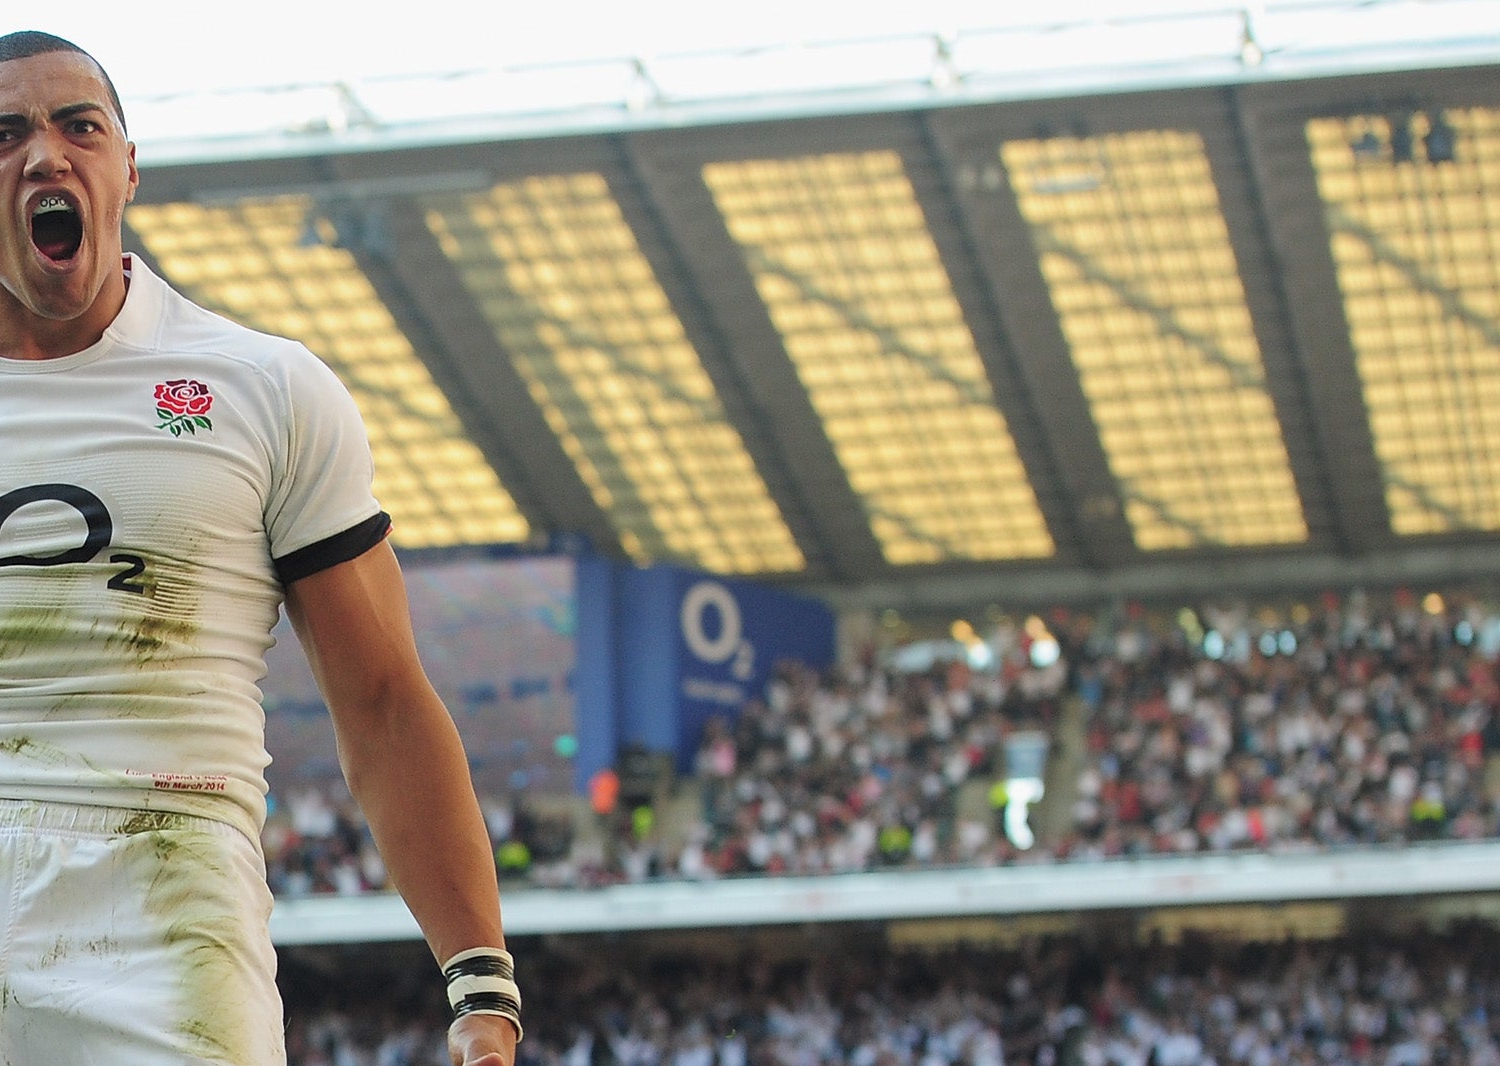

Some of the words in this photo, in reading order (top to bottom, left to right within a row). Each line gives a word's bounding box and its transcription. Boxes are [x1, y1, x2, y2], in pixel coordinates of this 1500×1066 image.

[154, 780, 170, 788] 9th
[172, 782, 202, 790] March
[204, 782, 225, 790] 2014
